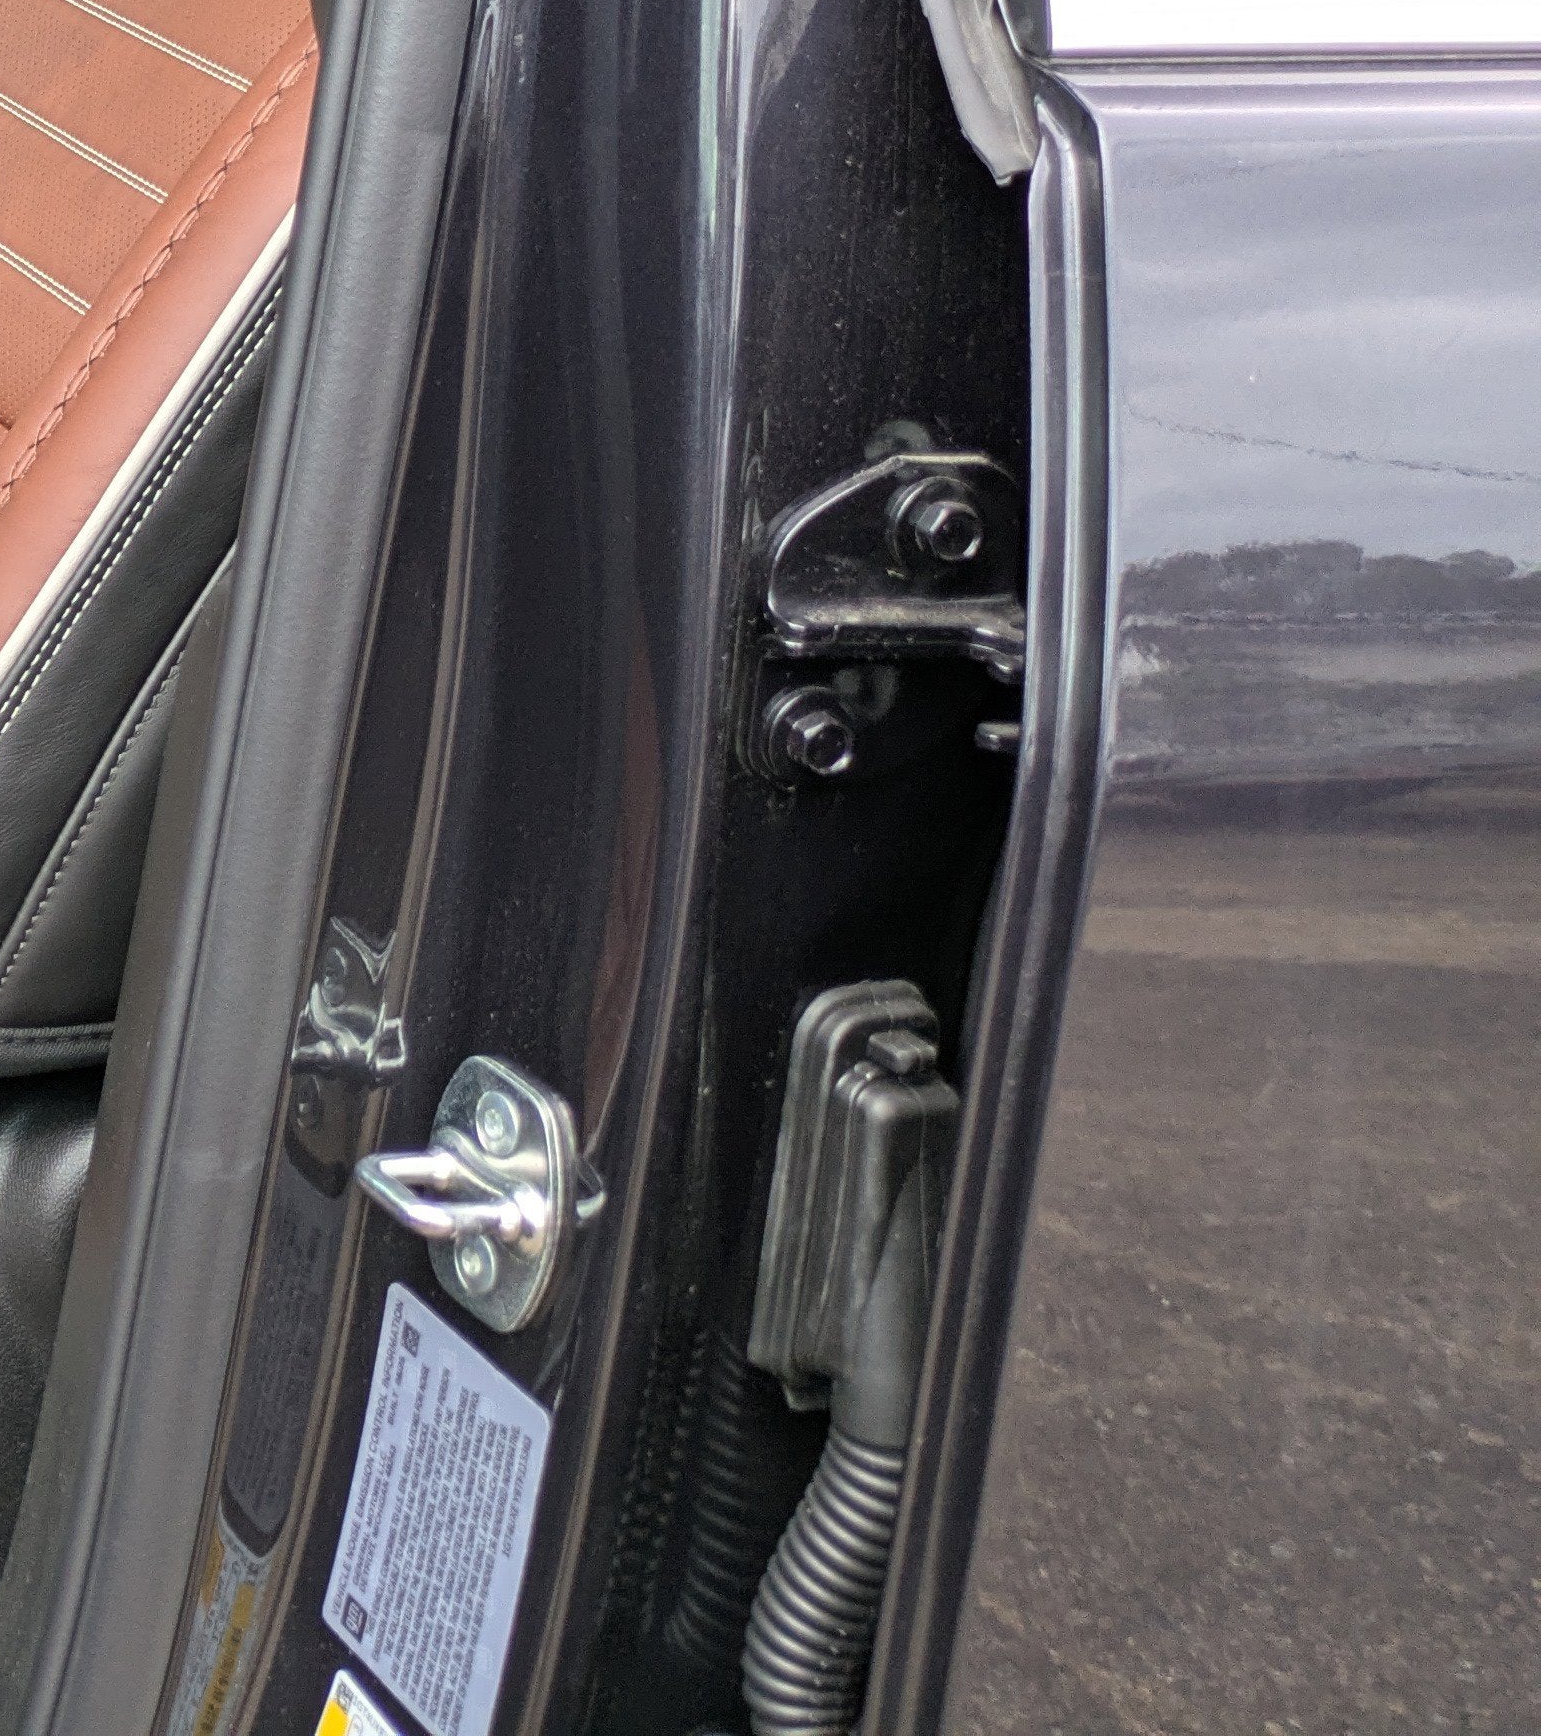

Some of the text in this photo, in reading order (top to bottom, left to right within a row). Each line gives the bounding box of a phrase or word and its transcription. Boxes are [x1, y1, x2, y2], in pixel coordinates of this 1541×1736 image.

[345, 1516, 360, 1561] NOISE
[354, 1452, 374, 1519] EMISSION
[367, 1388, 387, 1455] CONTROL
[379, 1297, 405, 1389] INFORMATION
